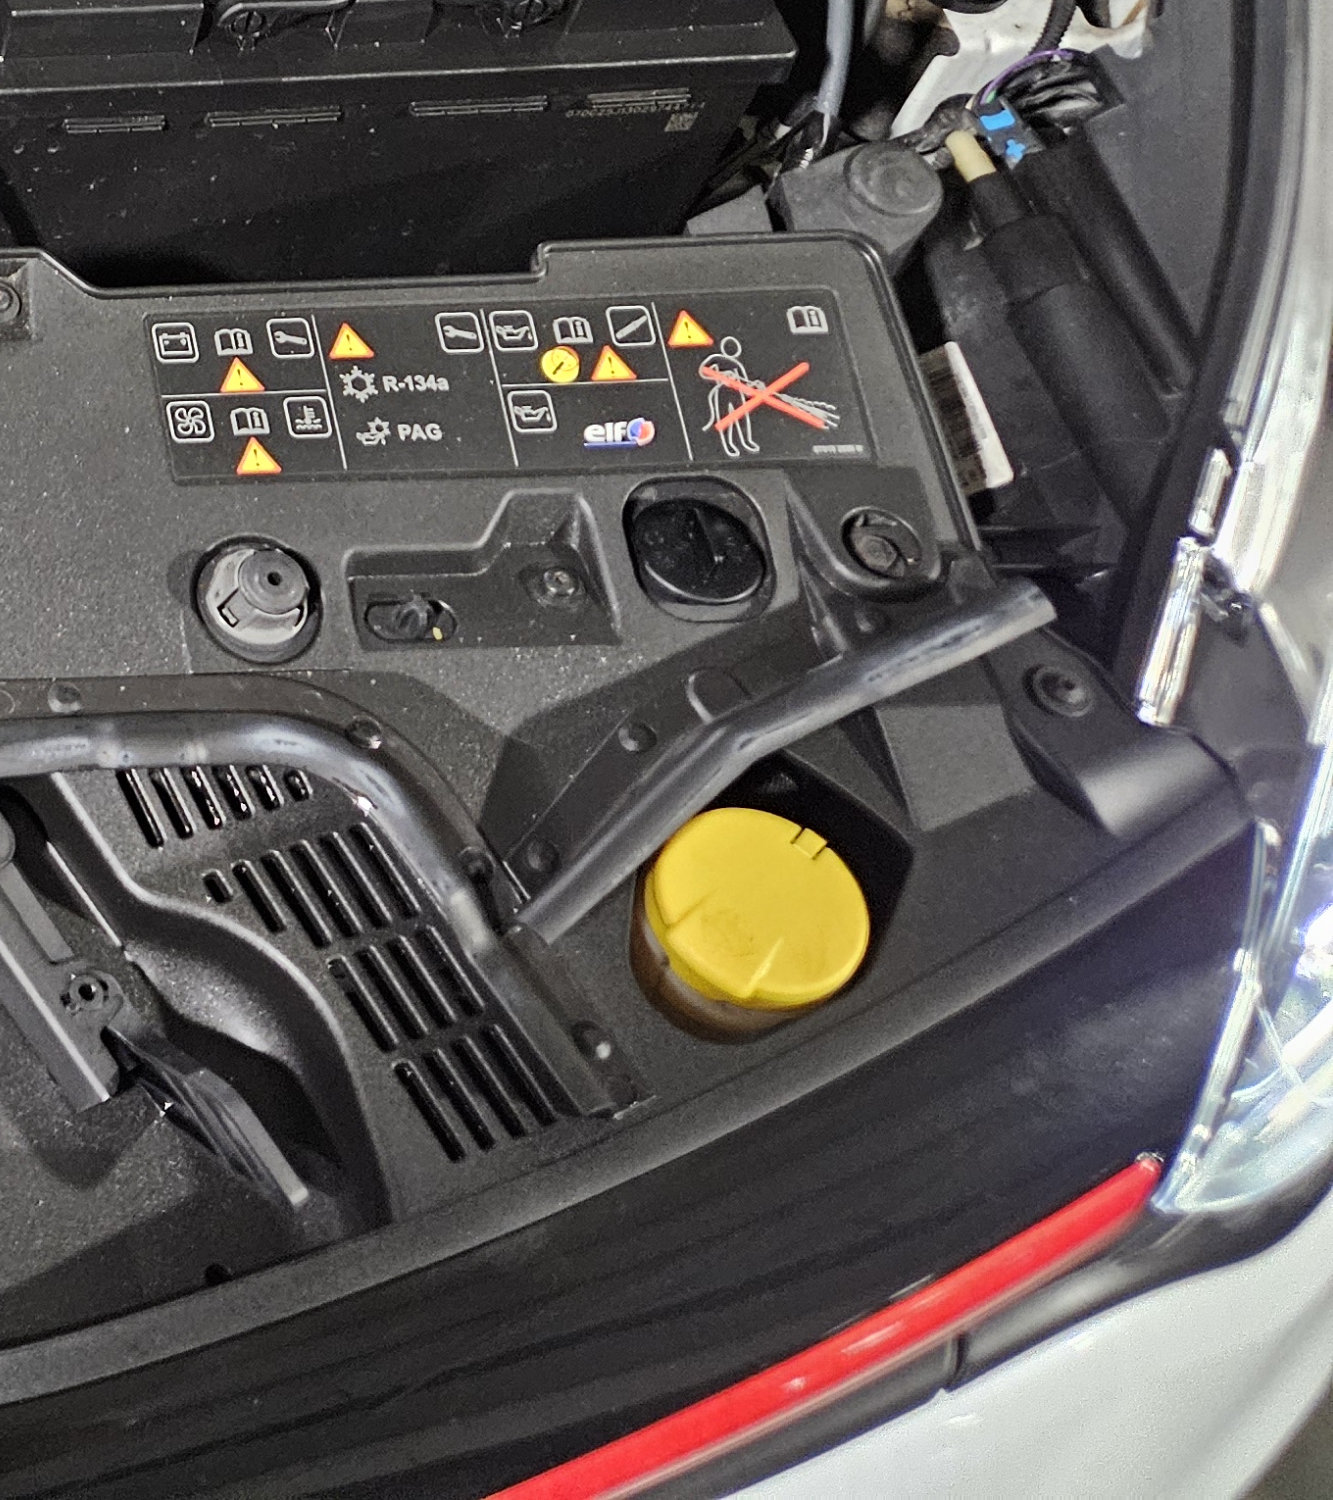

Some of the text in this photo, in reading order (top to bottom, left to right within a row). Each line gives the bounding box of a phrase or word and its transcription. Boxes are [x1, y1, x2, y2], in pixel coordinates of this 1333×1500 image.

[383, 375, 449, 394] R-134a
[397, 424, 442, 442] PAG
[584, 422, 626, 443] elf
